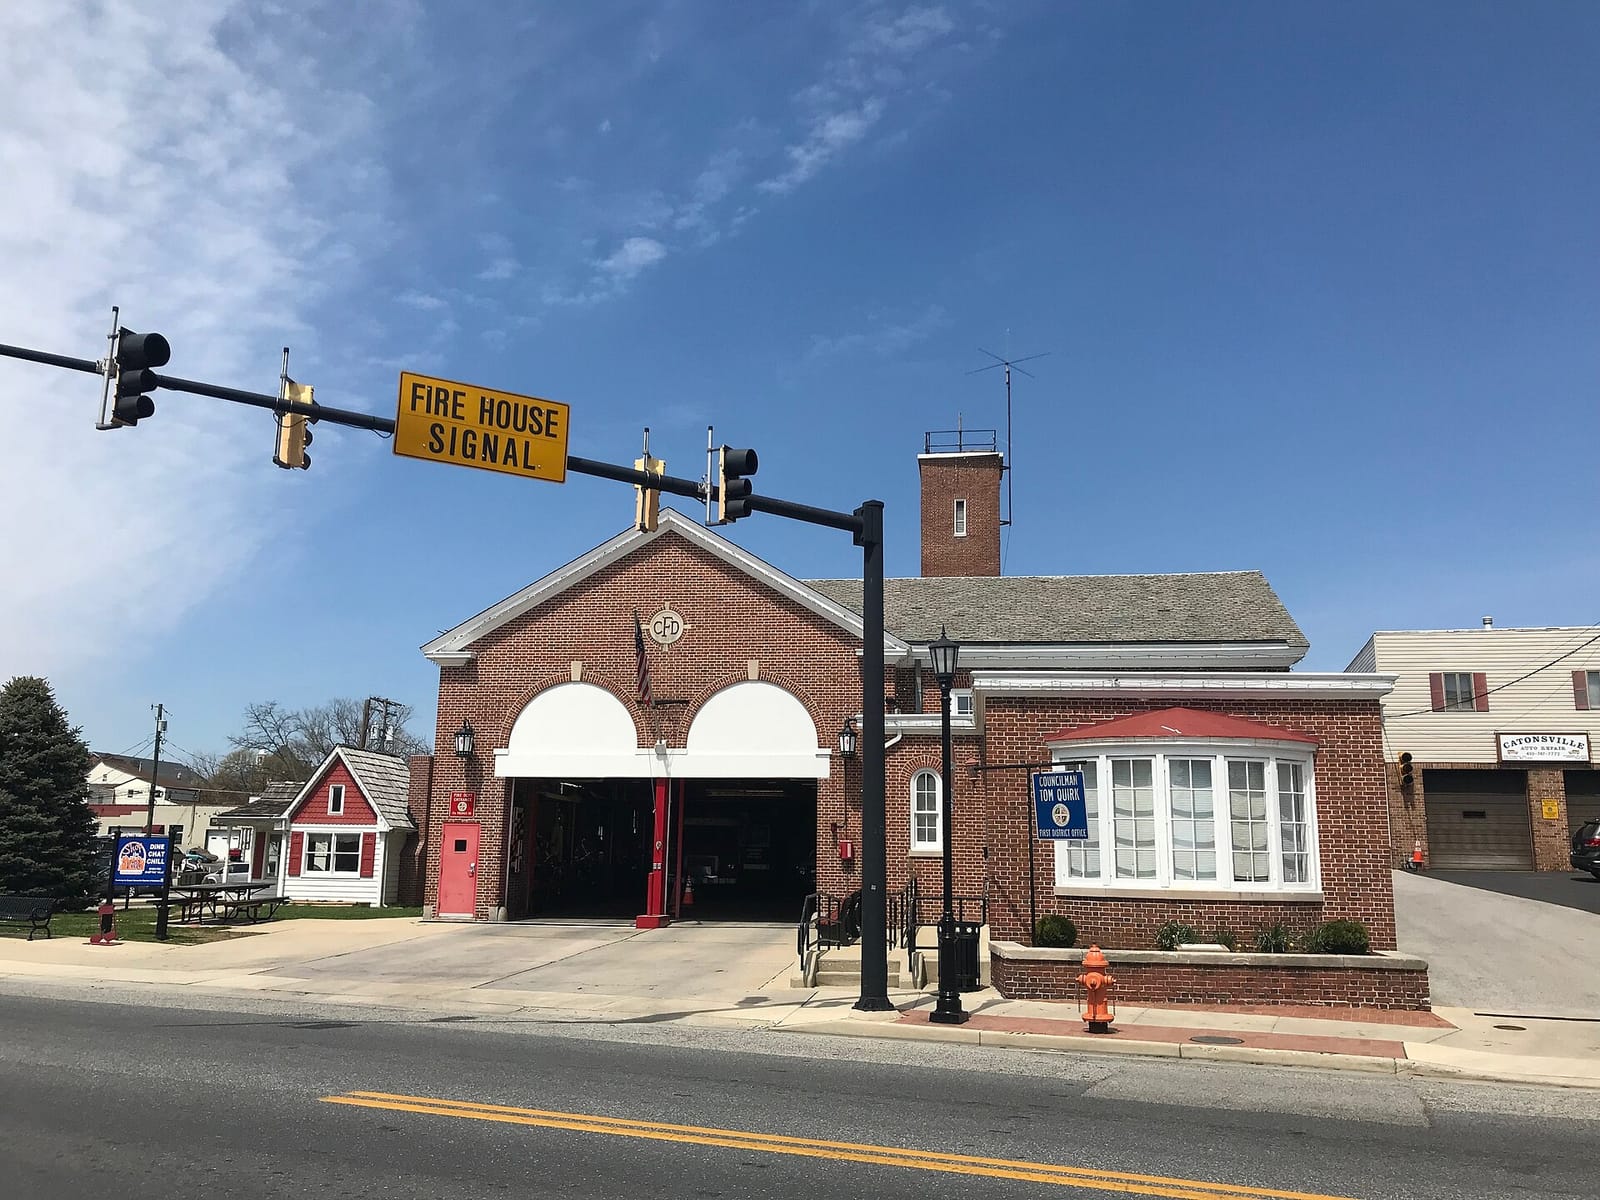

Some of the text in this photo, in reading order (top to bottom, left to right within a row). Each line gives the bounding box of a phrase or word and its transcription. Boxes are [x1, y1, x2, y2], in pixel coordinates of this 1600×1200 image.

[411, 382, 559, 438] FIRE HOUSE
[429, 422, 536, 470] SIGNAL
[653, 616, 680, 638] CFD
[1503, 736, 1585, 750] CATONSVILLE
[1039, 775, 1078, 787] COUNCILMAN
[1039, 787, 1080, 802] TOM QUIRK
